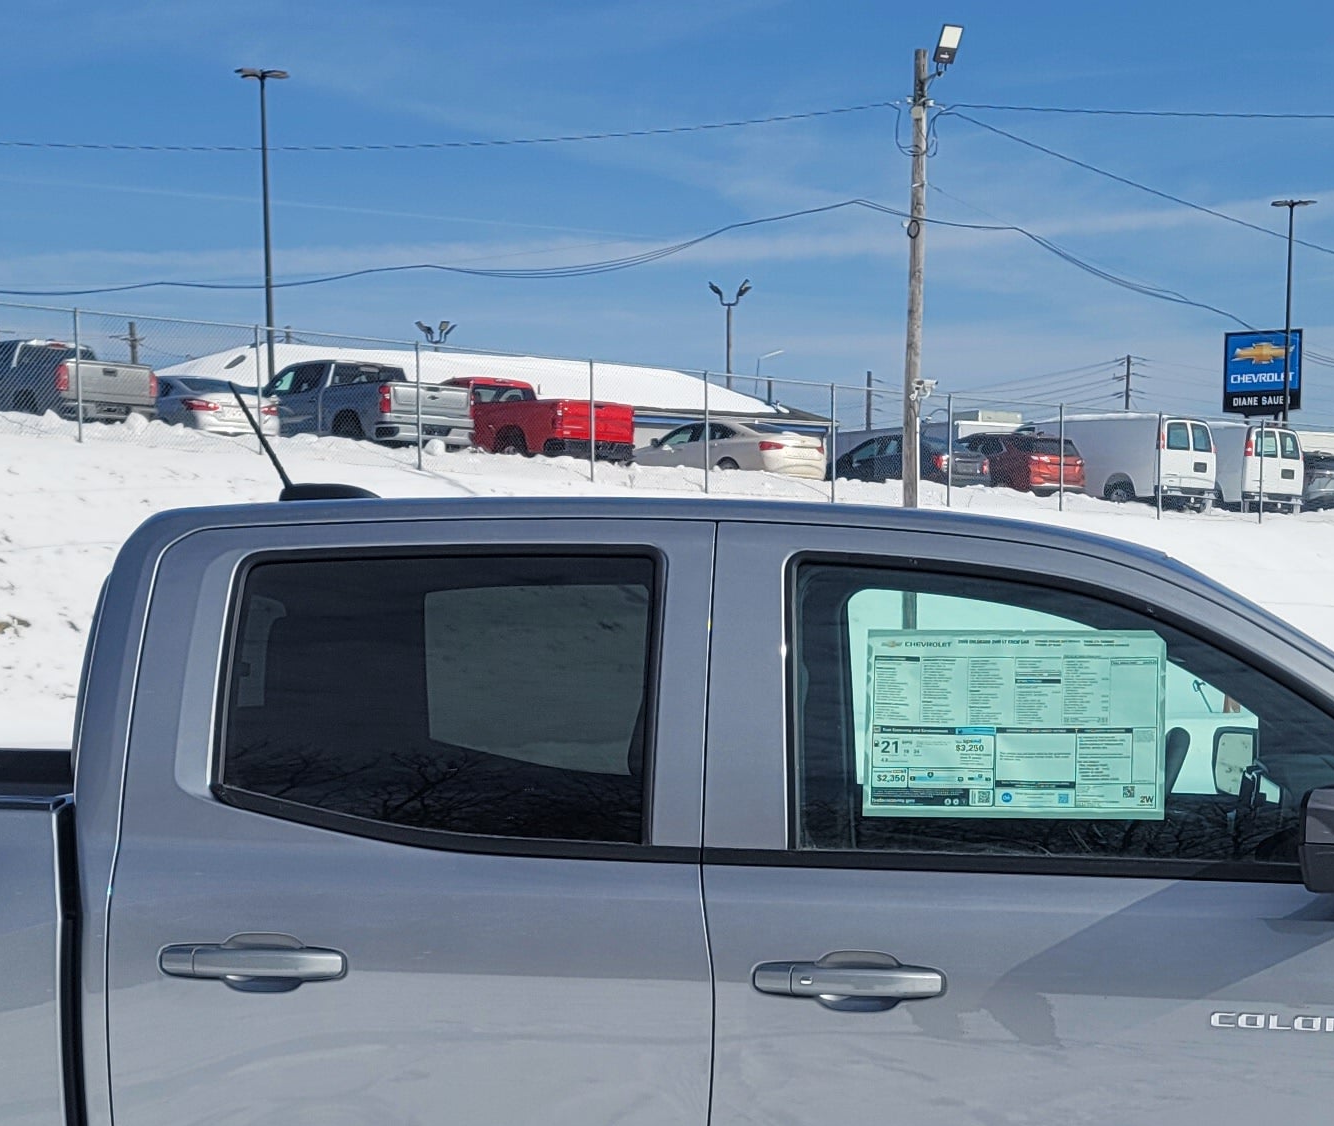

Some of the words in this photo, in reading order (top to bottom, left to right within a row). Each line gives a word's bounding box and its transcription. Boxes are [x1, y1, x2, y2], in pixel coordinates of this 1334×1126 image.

[1232, 396, 1259, 407] DIANE
[1261, 395, 1291, 405] SAUE
[881, 740, 899, 754] 21
[876, 773, 906, 783] $2,350
